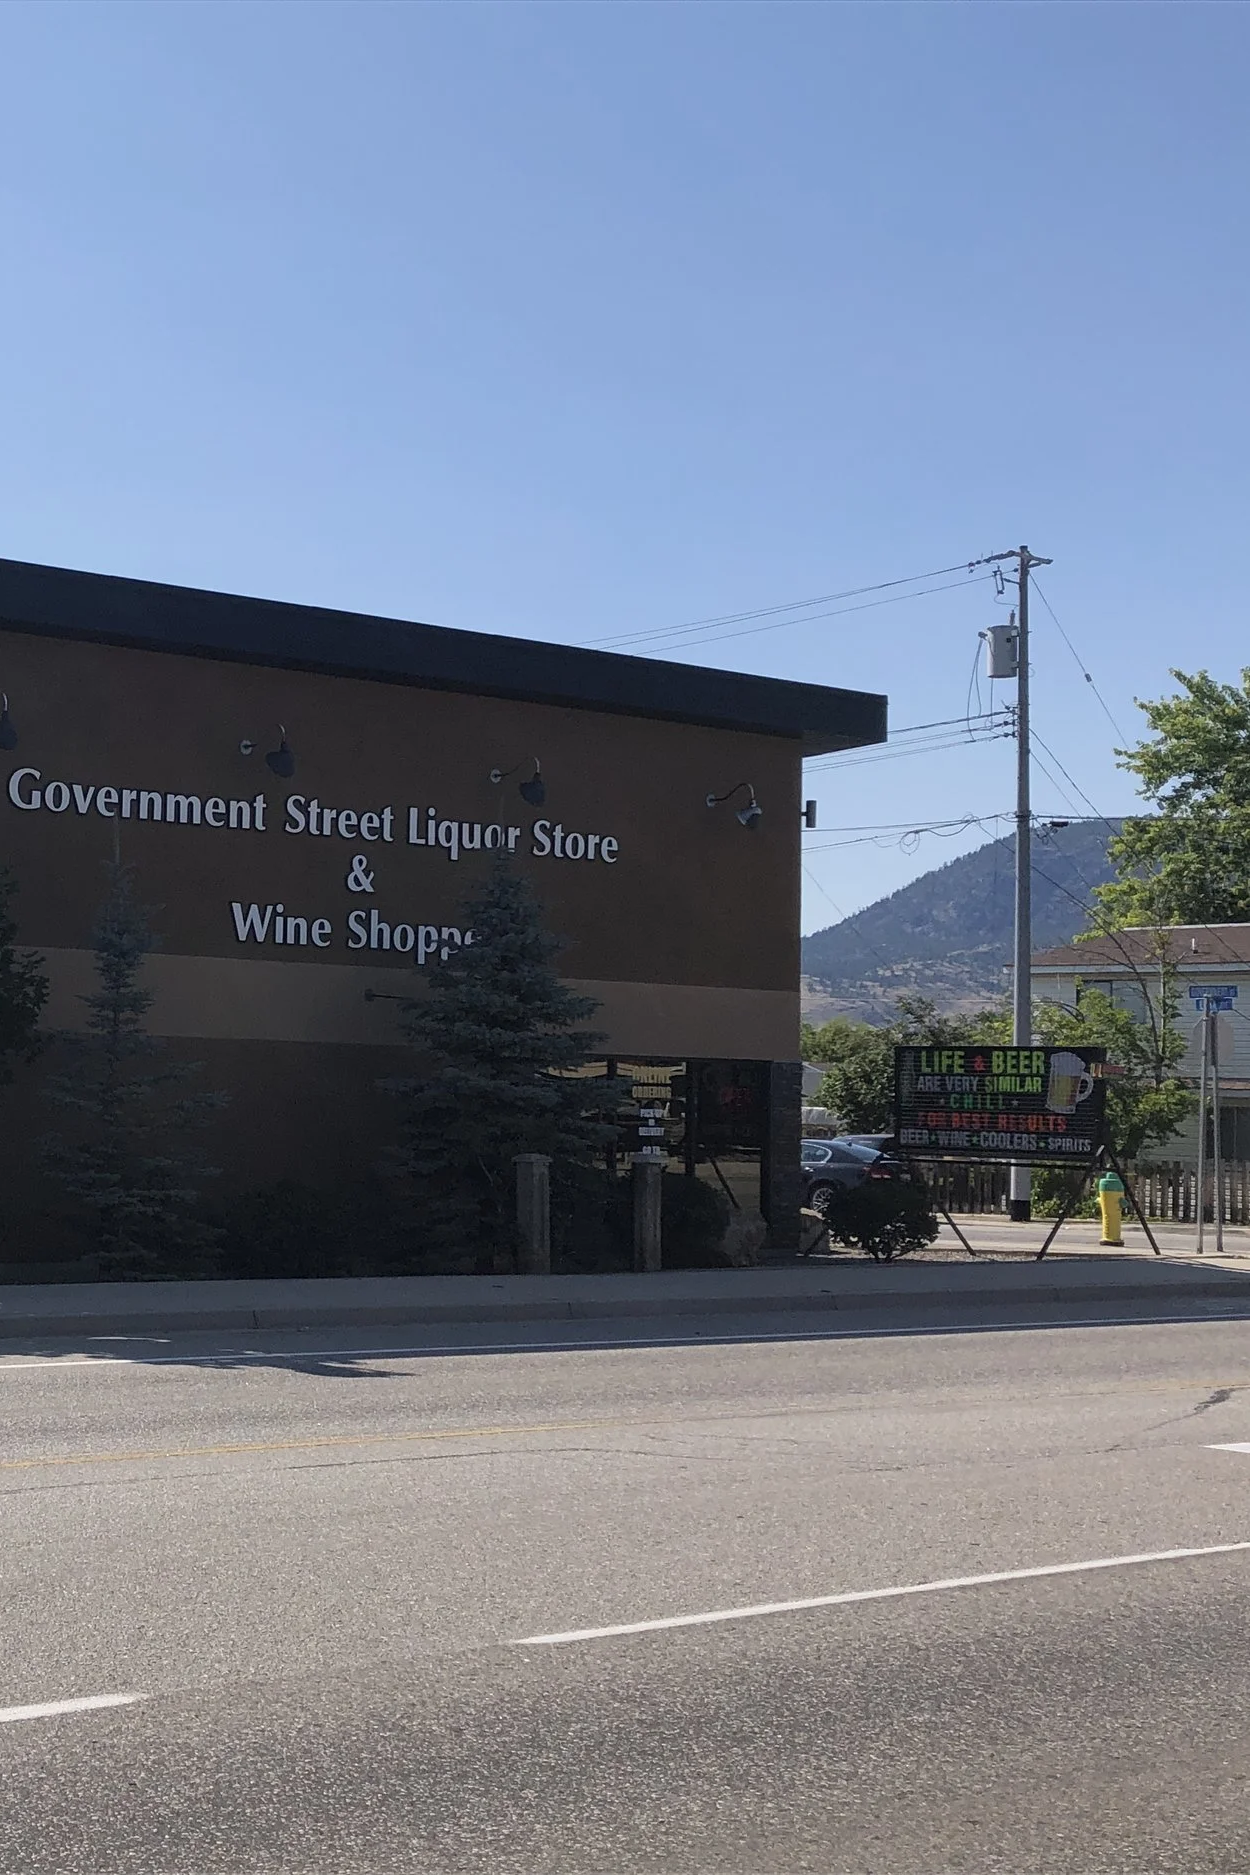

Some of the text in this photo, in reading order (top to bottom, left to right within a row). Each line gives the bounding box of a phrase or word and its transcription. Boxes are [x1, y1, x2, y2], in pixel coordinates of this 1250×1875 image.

[8, 768, 619, 863] Government Street Liquor Store
[346, 854, 375, 893] &
[231, 902, 333, 948] Wine
[921, 1050, 965, 1074] LIFE
[992, 1050, 1045, 1074] BEER
[917, 1076, 1042, 1093] ARE VERY SIMILAR
[949, 1093, 1006, 1110] CHILL
[951, 1112, 990, 1130] BEST
[997, 1113, 1068, 1133] RESULTS
[900, 1128, 1092, 1153] BEER WINE COOLERS SPIRITS
